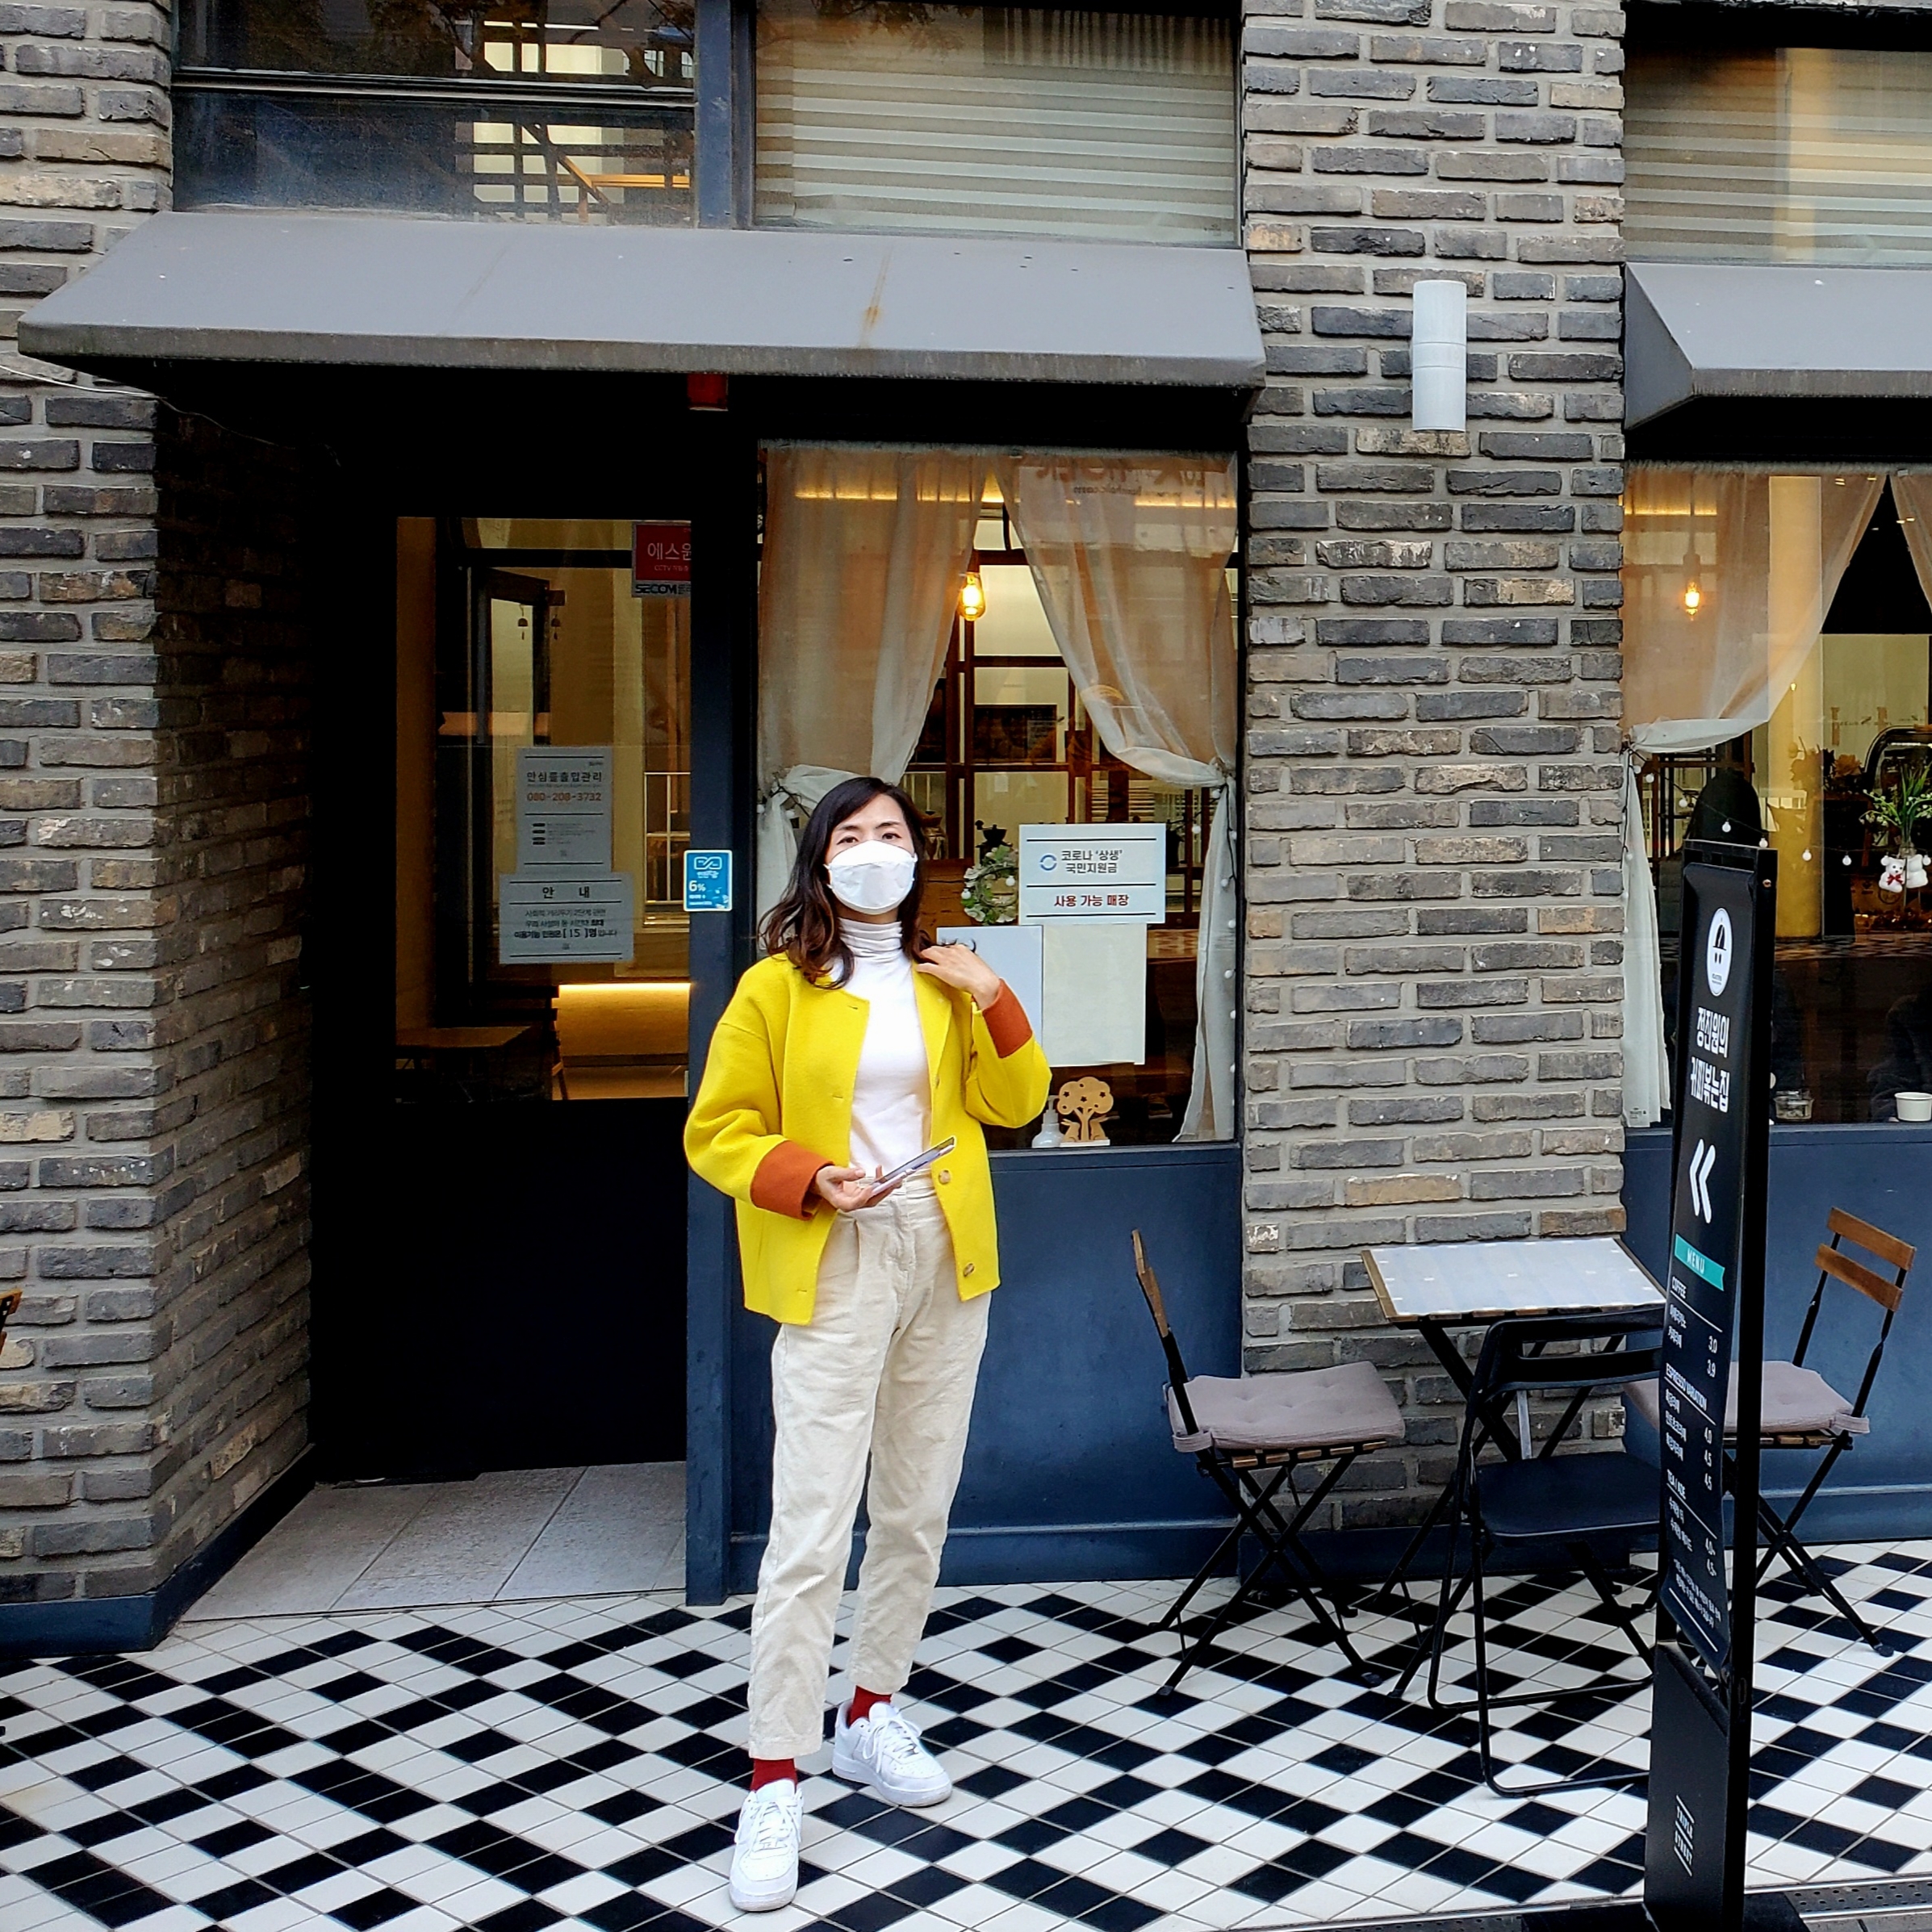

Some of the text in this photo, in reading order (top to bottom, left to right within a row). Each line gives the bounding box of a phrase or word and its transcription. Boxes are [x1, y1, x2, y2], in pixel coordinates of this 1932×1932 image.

[635, 583, 677, 595] SECOM
[1061, 850, 1093, 861] 코로나
[1065, 863, 1117, 874] 국민지원금
[688, 880, 706, 892] 6%
[1054, 894, 1130, 907] 사용 가능 매장
[1691, 1056, 1729, 1113] 커피볶는집
[1687, 1248, 1705, 1274] MENU
